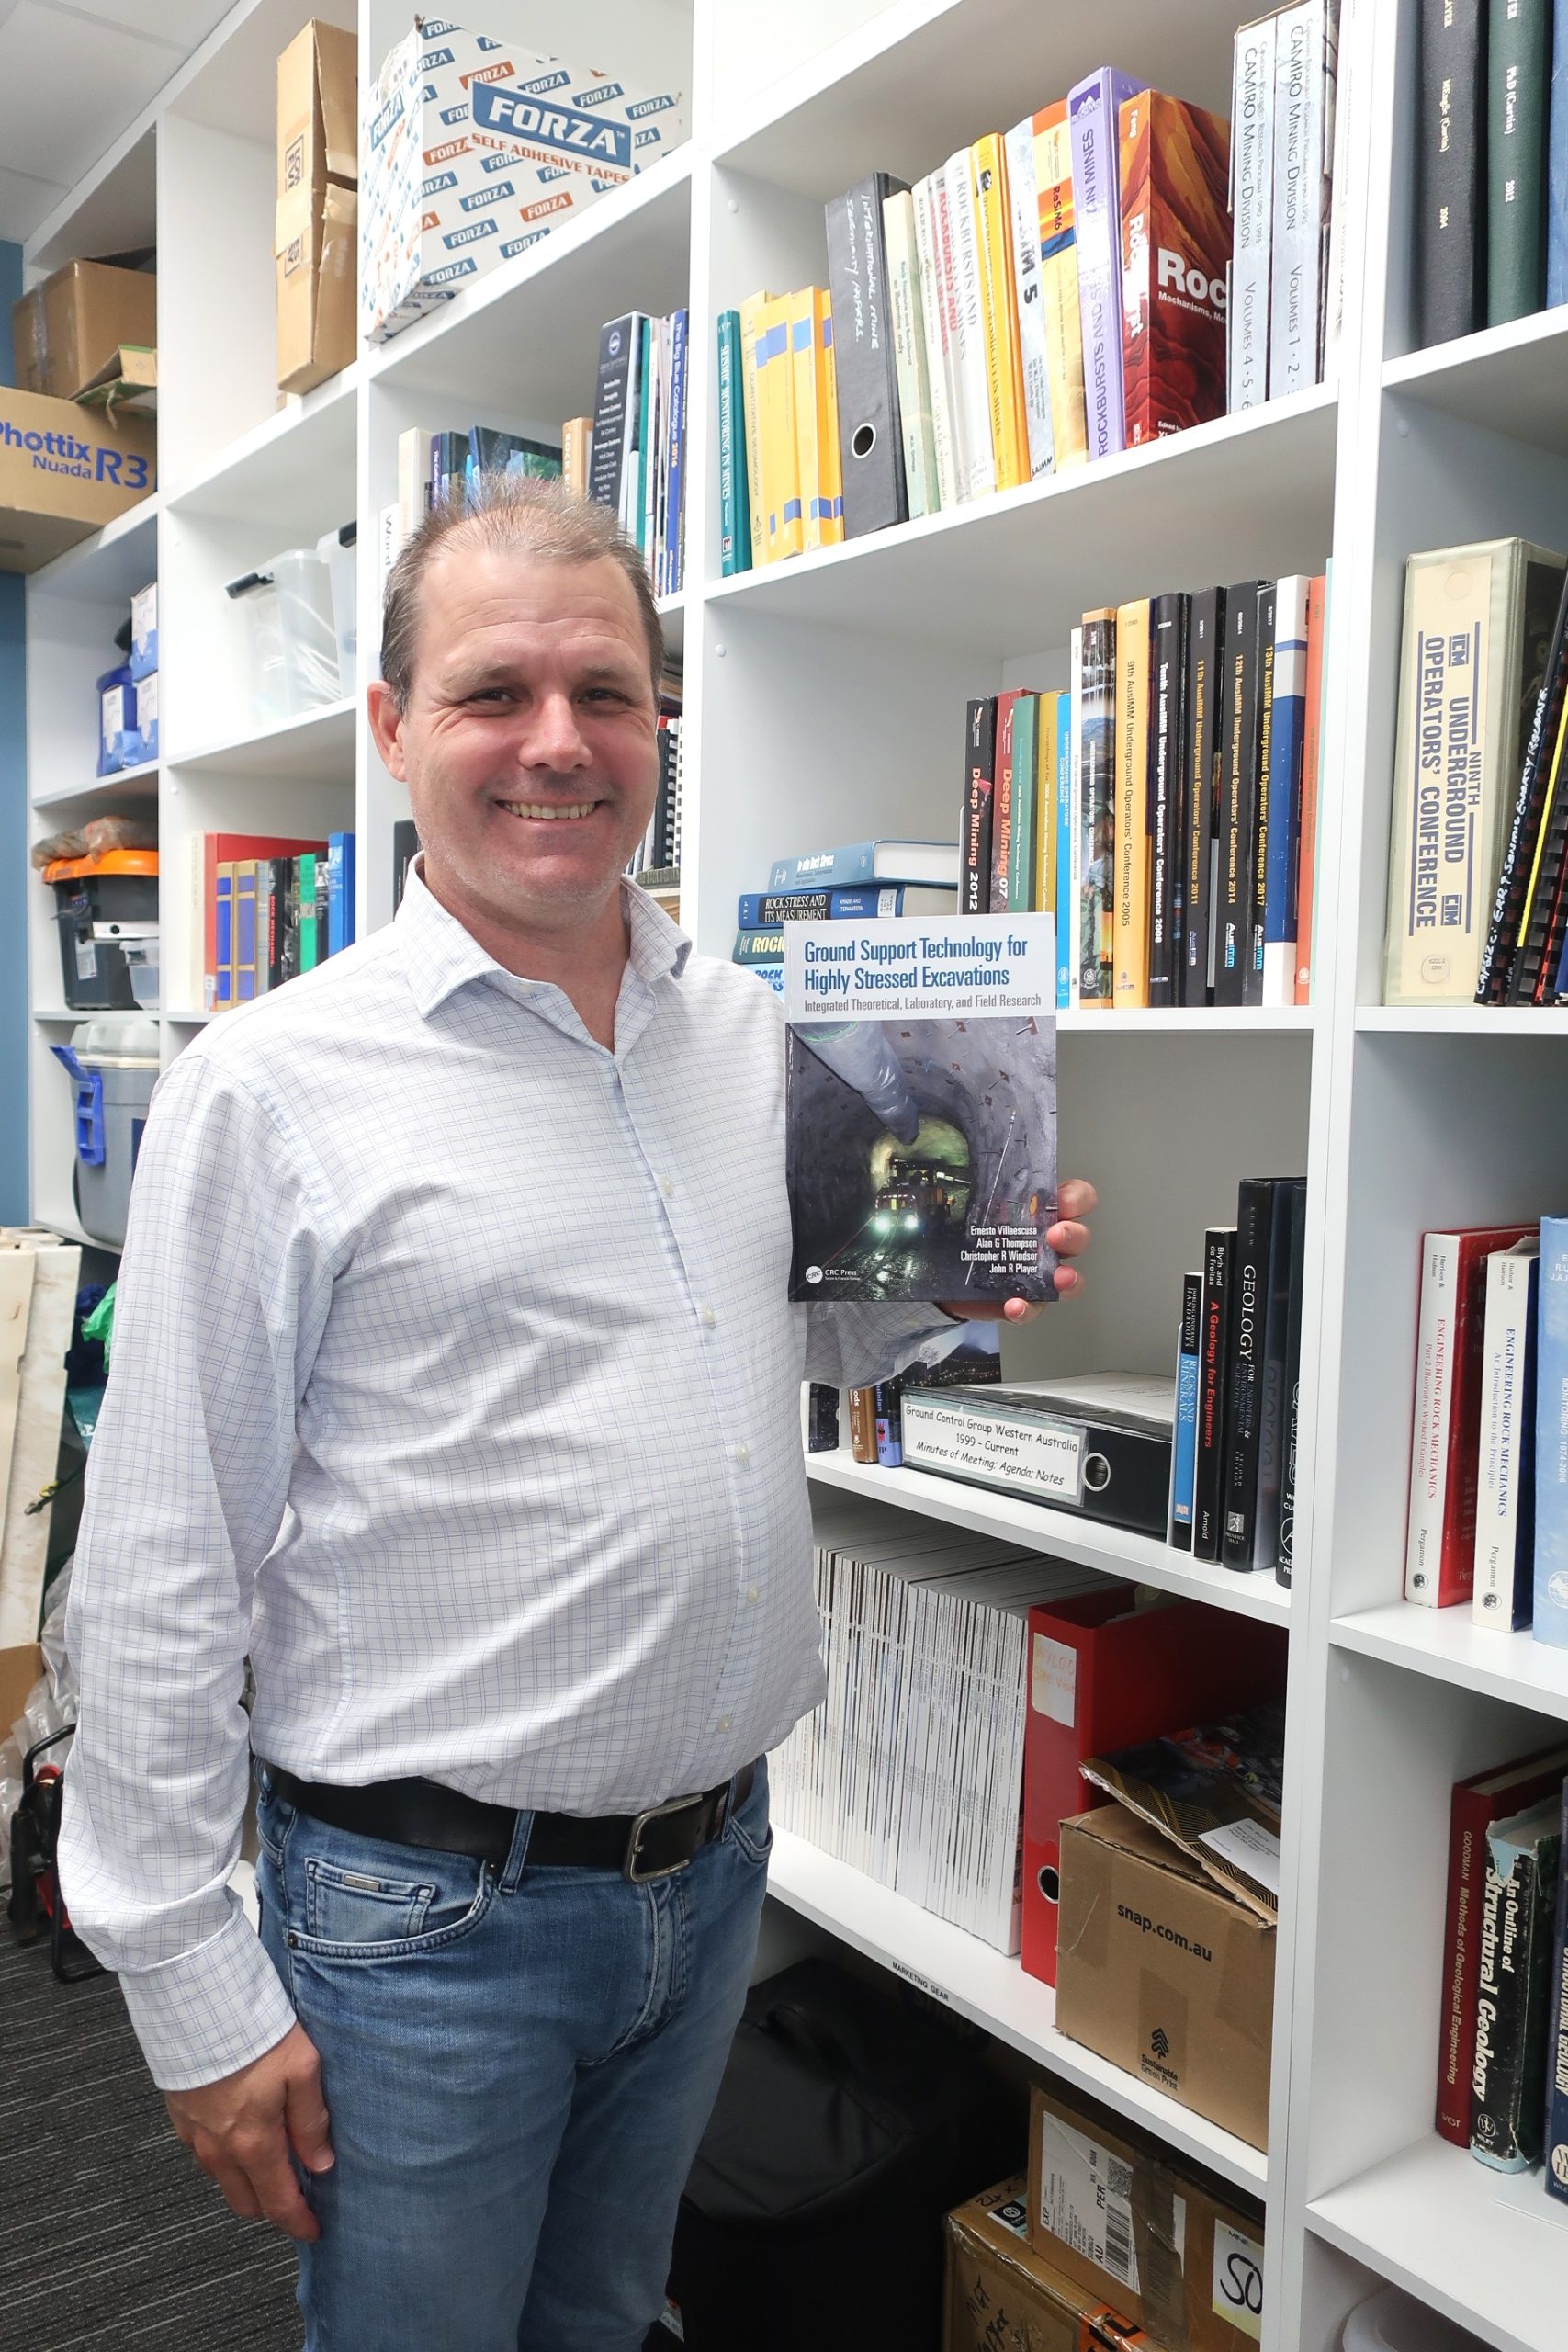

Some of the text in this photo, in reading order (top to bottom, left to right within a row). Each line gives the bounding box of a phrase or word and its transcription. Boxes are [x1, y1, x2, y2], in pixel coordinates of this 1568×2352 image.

[580, 85, 619, 107] FORZA
[632, 97, 671, 119] FORZA
[489, 96, 617, 157] FORZA
[472, 133, 631, 183] SELF ADHESIVE TAPES
[1081, 128, 1096, 184] MINES
[468, 184, 509, 210] FORZA
[1240, 46, 1257, 350] CAMIRO MINING DIVISION VOLUMES
[1286, 26, 1303, 332] CAMIRO MINING DIVISION VOLUMES
[527, 196, 567, 220] FORZA
[451, 221, 491, 246] FORZA
[429, 262, 471, 284] FORZA
[1158, 290, 1212, 318] Mechanisms,
[673, 361, 682, 383] Blue
[721, 345, 730, 383] SEISMIC
[671, 384, 682, 441] Catalogue
[721, 389, 731, 448] MONITORING
[1092, 342, 1109, 457] ROCKBURSTS
[32, 447, 148, 490] Nuada R3
[722, 467, 731, 499] MINES
[1122, 661, 1135, 927] 9th AusIMM Underground Operators' Conference 2005
[1190, 660, 1205, 905] 11th AusIMM Underground Operators' Conference 2011
[1228, 653, 1244, 904] 12th AusIMM Underground Operators' Conference 2014
[1257, 645, 1273, 906] 13th AusIMM Underground Operators' Conference 2017
[1417, 636, 1446, 928] OPERATORS' CONFERENCE
[1444, 633, 1469, 926] ICM UNDERGROUND CIM
[1468, 751, 1482, 806] NINTH
[1155, 662, 1168, 943] Tenth AusIMM Underground Operators' Conference 2008
[969, 767, 981, 910] Deep Mining 2012
[998, 768, 1012, 899] Deep Mining 07
[764, 909, 827, 922] ITS MEASUREMENT
[765, 894, 826, 909] ROCK STRESS AND
[805, 935, 1028, 965] Ground Support Technology for
[805, 965, 1010, 995] Highly Stressed Excavations
[805, 993, 1042, 1014] Integrated Theoretical, Laboratory, and Field Research
[970, 1225, 1038, 1236] Ernesto Villaescusa
[976, 1238, 1038, 1250] Alan G Thompson
[960, 1250, 1038, 1263] Christopher R Windsor
[989, 1263, 1038, 1276] John R Player
[1216, 1246, 1224, 1269] Blyth
[1239, 1264, 1257, 1361] GEOLOGY
[1179, 1359, 1190, 1422] MINERALS
[1187, 1359, 1197, 1423] ROCKS AND
[1204, 1301, 1219, 1449] A Geology for Engineers
[906, 1405, 1077, 1453] Ground Control Group Western Australia
[1427, 1317, 1446, 1499] ENGINEERING ROCK MECHANICS
[1497, 1328, 1516, 1517] ENGINEERING ROCK MECHANICS
[916, 1441, 949, 1458] Minutes
[950, 1448, 960, 1461] of
[1035, 1469, 1065, 1486] Notes
[956, 1433, 1019, 1456] 1999 Current
[1489, 1449, 1500, 1489] Principles
[1201, 1510, 1210, 1540] Arnold
[1418, 1527, 1428, 1566] Pergamon
[1489, 1545, 1500, 1588] Pergamon
[1117, 1904, 1213, 1962] snap.com.au
[1502, 1877, 1521, 1973] An Outline of
[1447, 1830, 1472, 2085] GOODMAN Methods of Geological Engineering
[892, 1960, 950, 2003] MARKETING GEAR
[1472, 1866, 1507, 2103] Structural Geology
[1141, 2053, 1179, 2082] Sustainable
[1161, 2075, 1179, 2091] Print
[1042, 2206, 1050, 2226] EXP
[1096, 2184, 1106, 2210] PER
